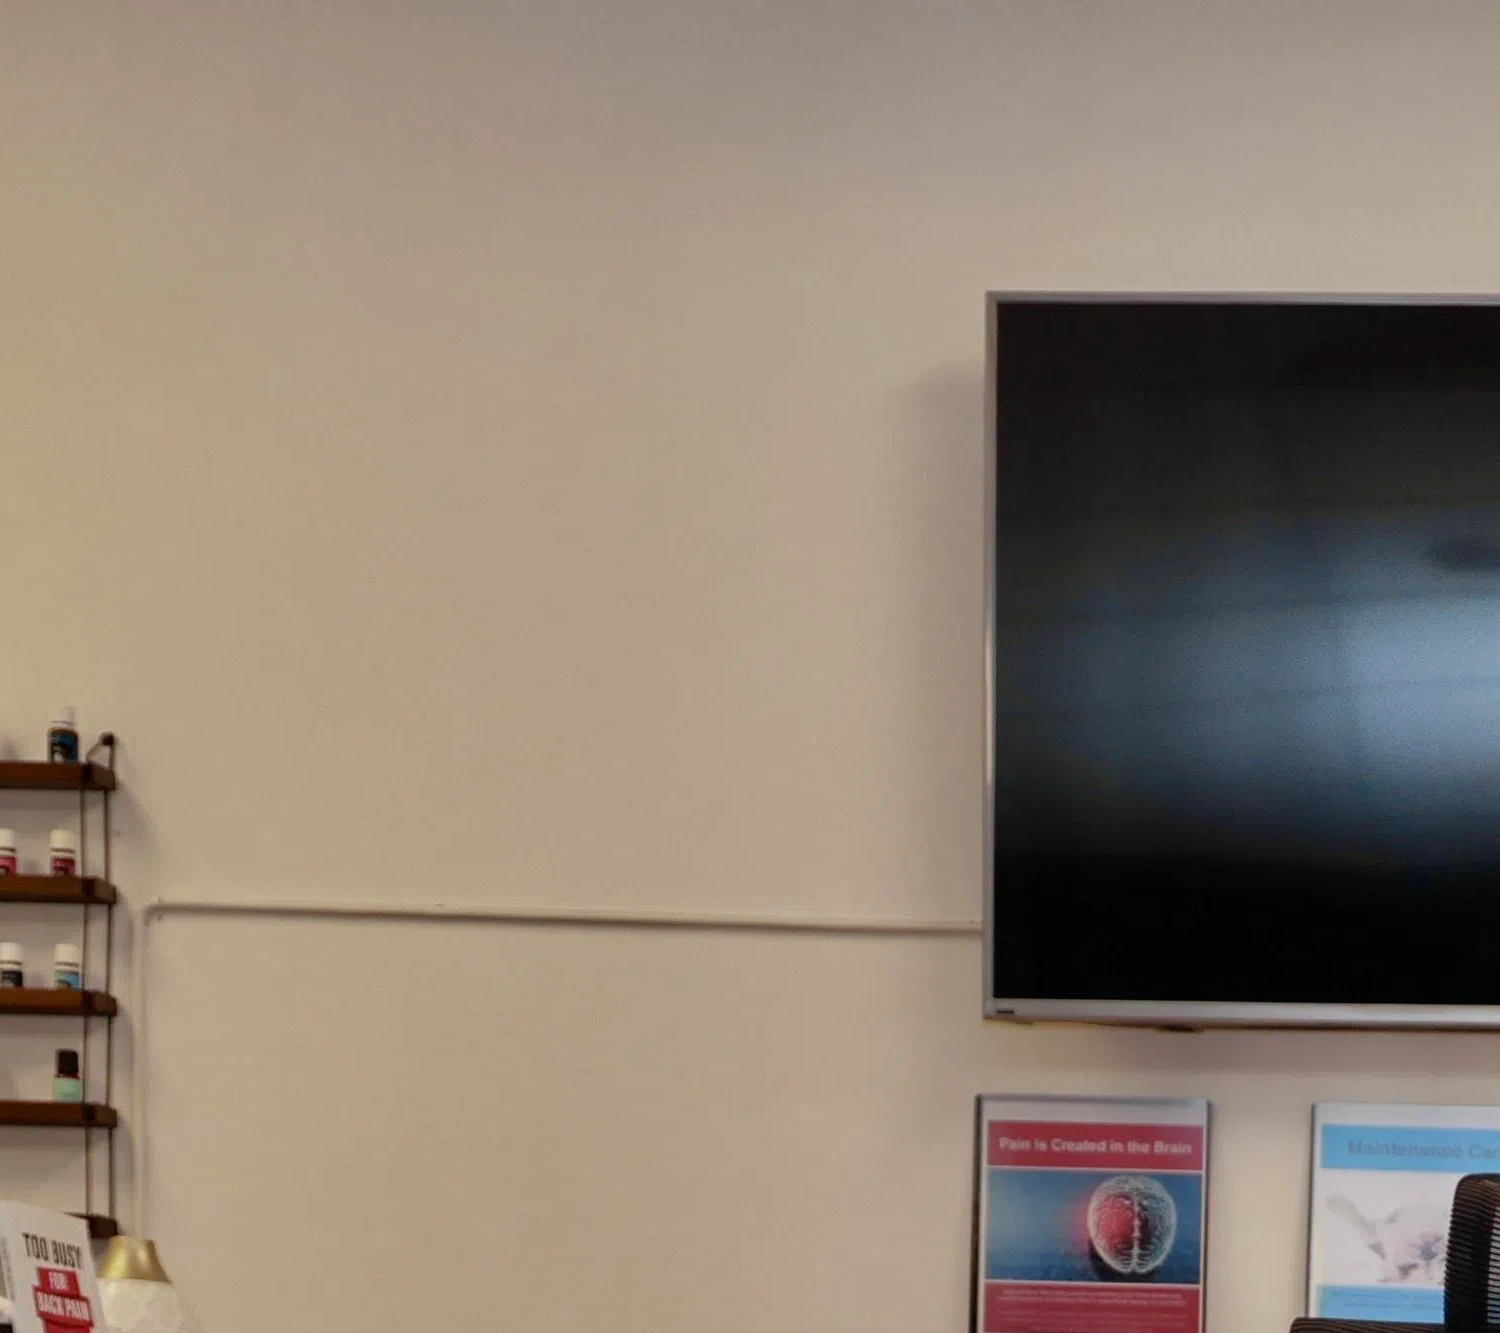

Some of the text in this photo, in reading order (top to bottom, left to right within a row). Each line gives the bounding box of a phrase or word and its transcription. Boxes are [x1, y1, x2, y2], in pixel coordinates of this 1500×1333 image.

[998, 1136, 1193, 1155] Pain is Created in the Brain
[1347, 1140, 1463, 1159] Maintenance
[21, 1232, 49, 1261] TOO
[51, 1239, 82, 1270] BUSY
[36, 1291, 91, 1321] BACK PAIN
